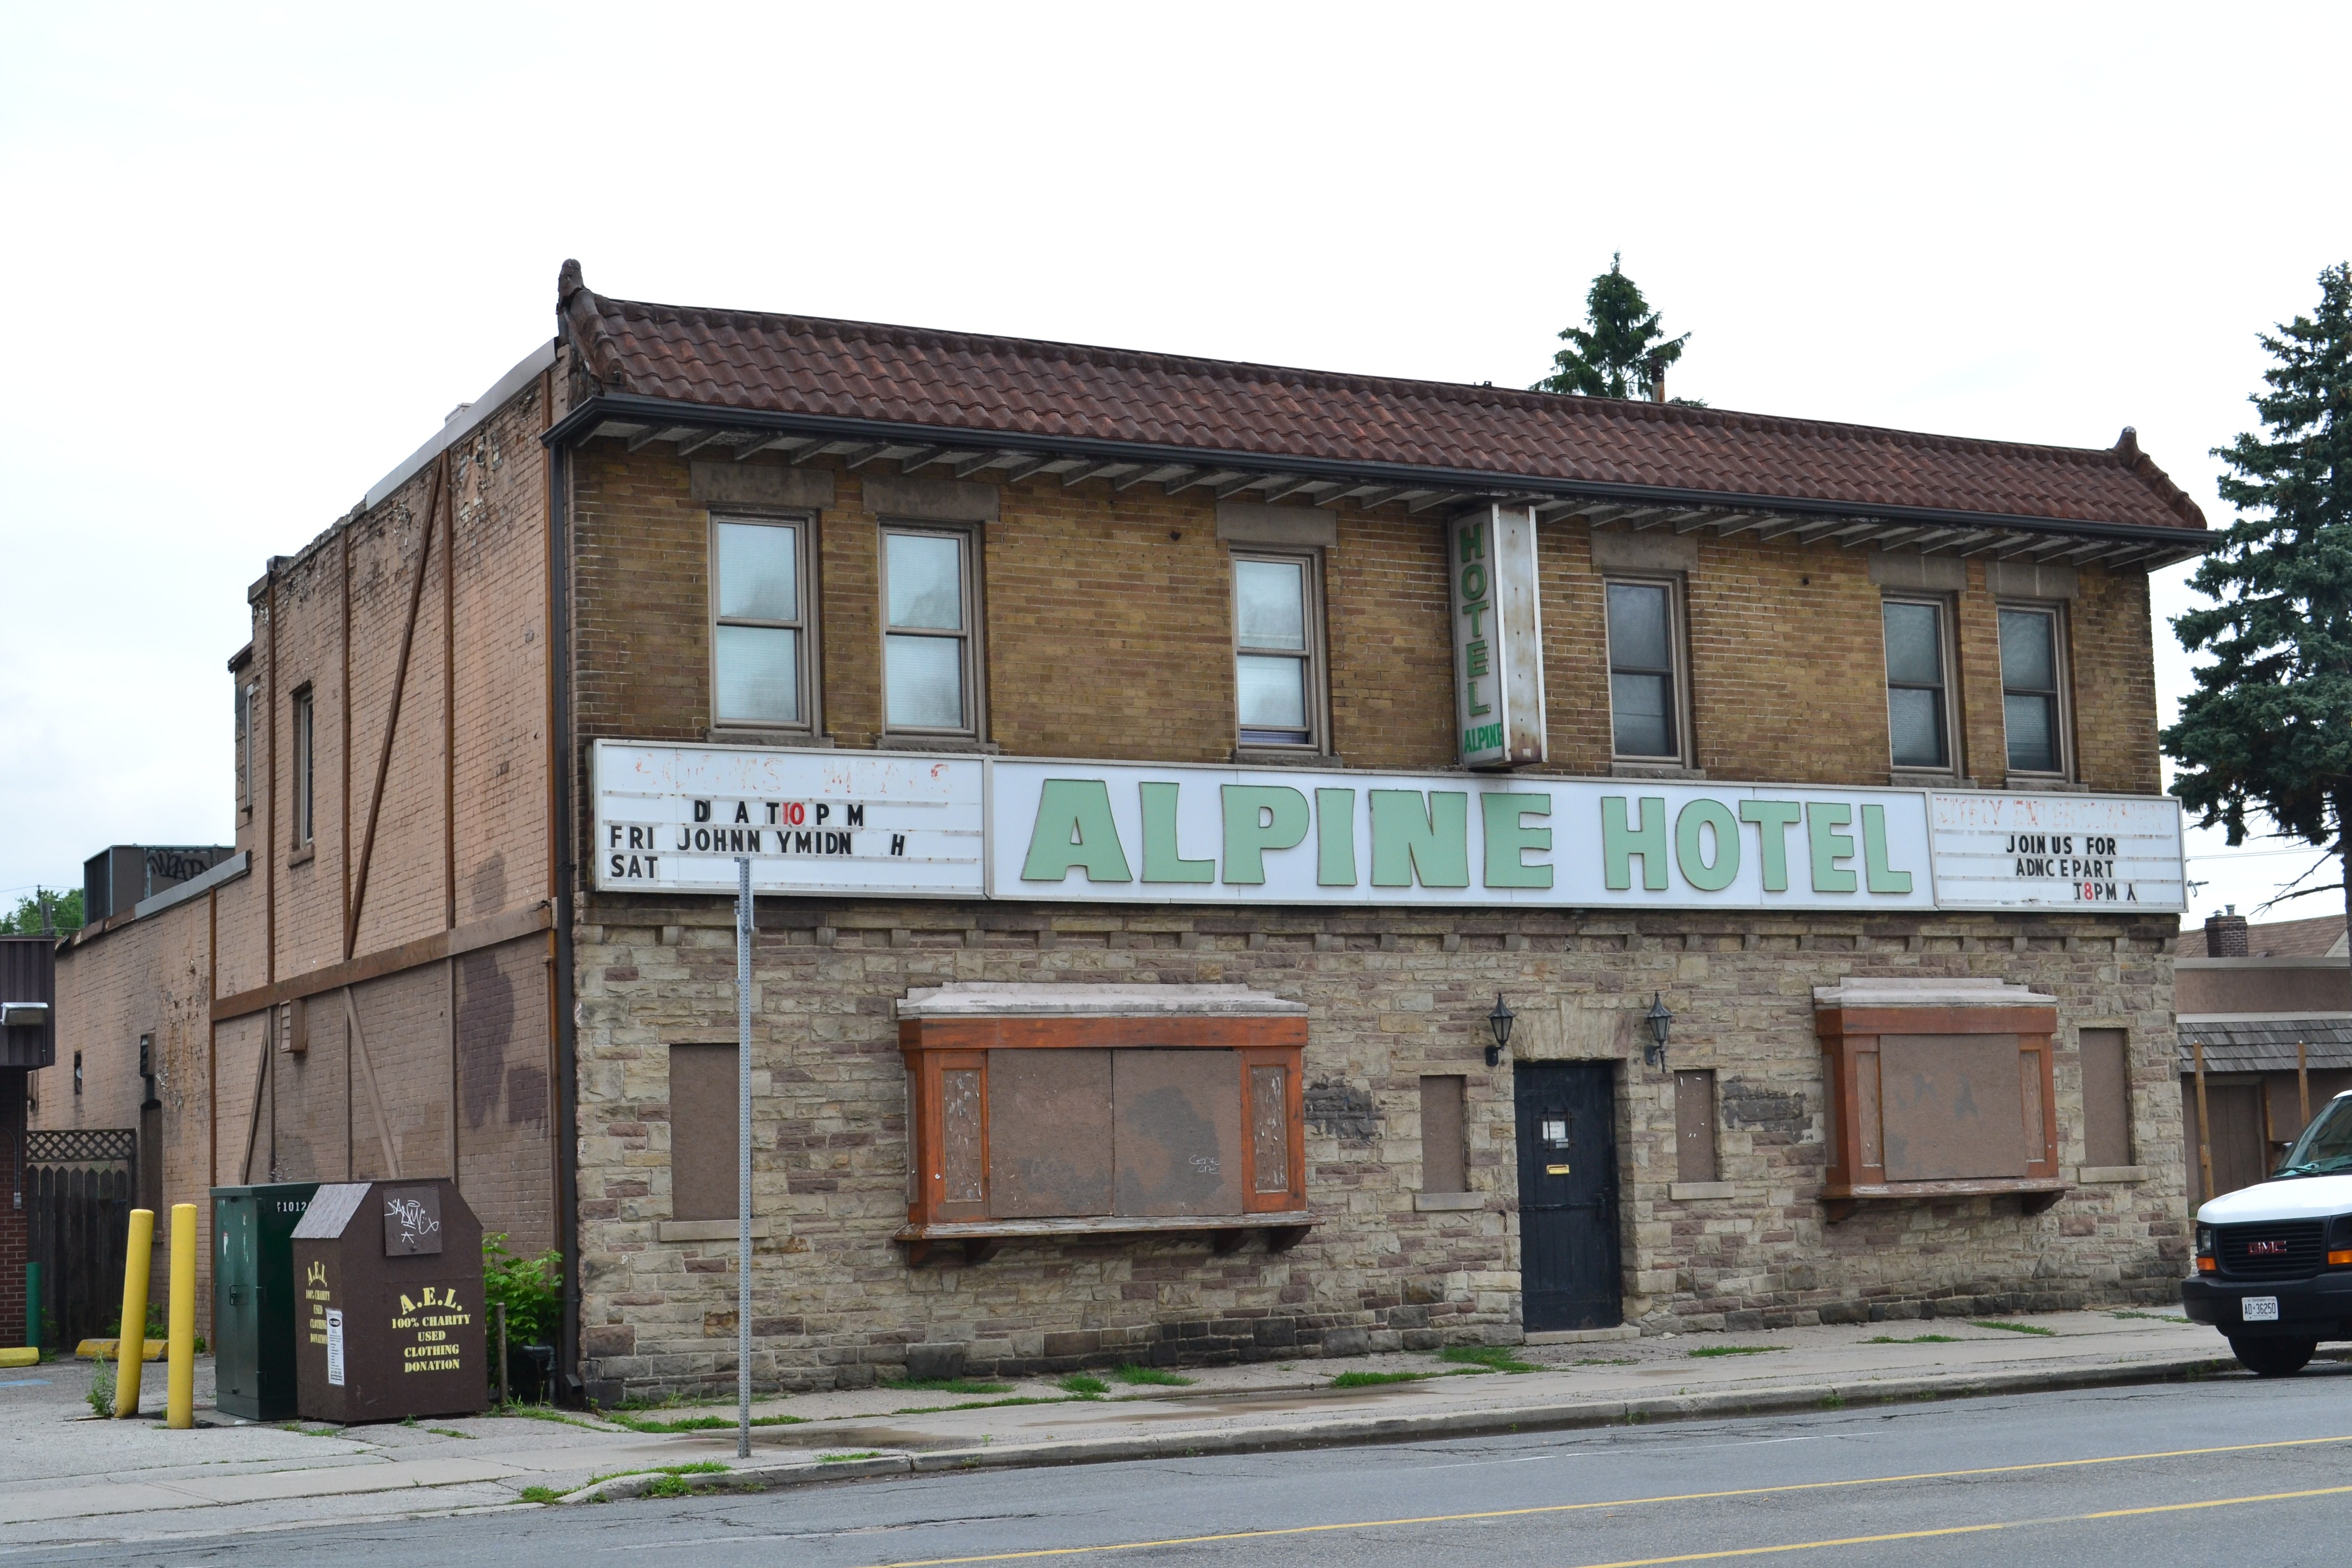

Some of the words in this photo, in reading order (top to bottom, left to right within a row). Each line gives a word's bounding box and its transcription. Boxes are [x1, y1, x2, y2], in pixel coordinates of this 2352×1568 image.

[1460, 523, 1491, 716] HOTEL
[1464, 722, 1502, 754] ALPINE
[611, 825, 653, 849] FRI
[890, 834, 905, 856] H
[1020, 778, 1554, 888] ALPINE
[1601, 796, 1913, 894] HOTEL
[2086, 837, 2116, 855] FOR
[611, 854, 658, 878] SAT
[2248, 1240, 2287, 1255] GMC
[400, 1287, 462, 1315] A.E.L.
[391, 1317, 420, 1329] 100%
[422, 1314, 471, 1327] CHARITY
[418, 1330, 446, 1342] USED
[404, 1344, 459, 1358] CLOTHING
[404, 1359, 460, 1373] DONATION
